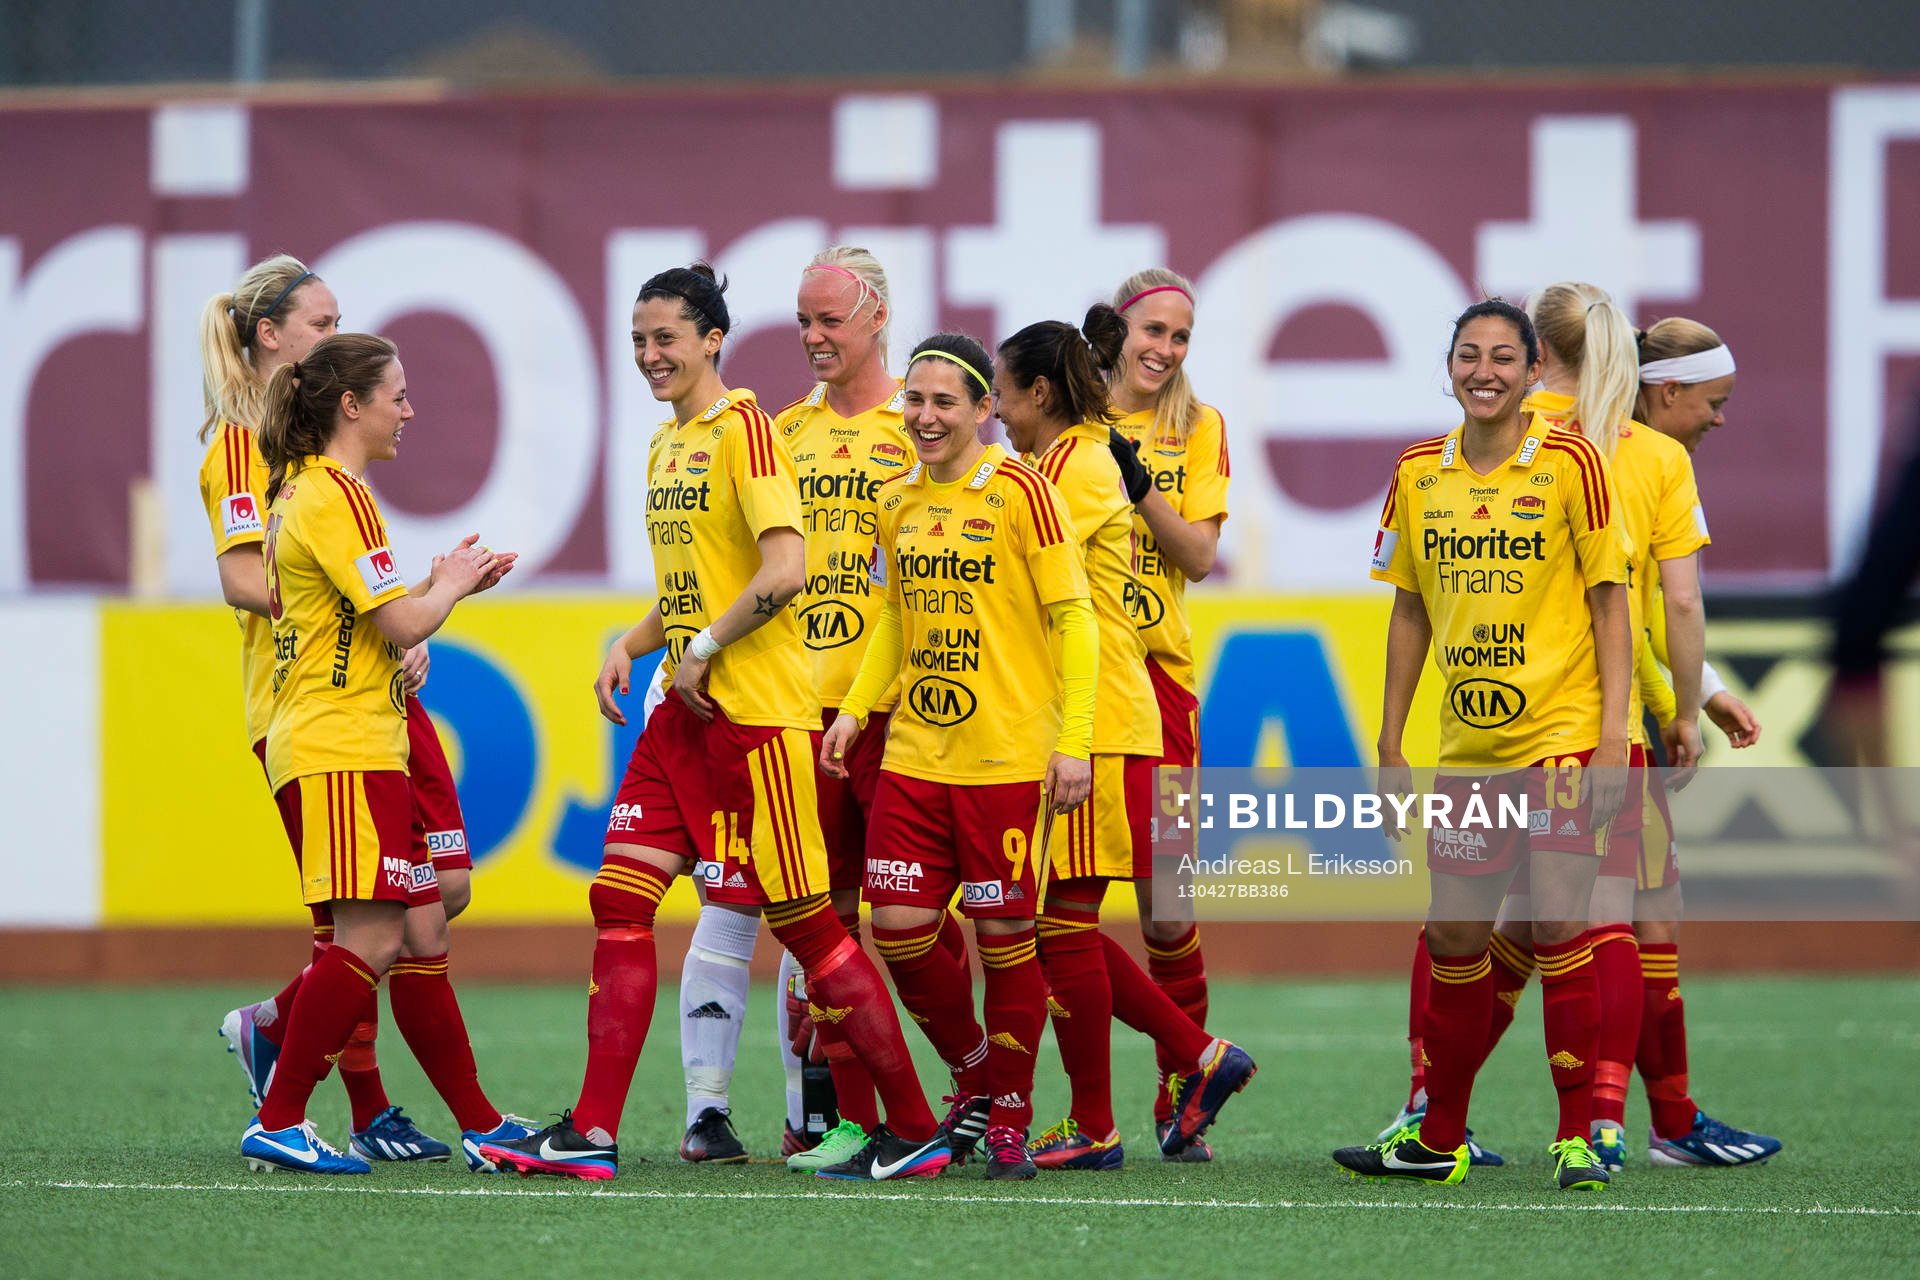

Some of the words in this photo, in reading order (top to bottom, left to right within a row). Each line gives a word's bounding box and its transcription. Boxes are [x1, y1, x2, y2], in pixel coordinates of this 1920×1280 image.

[0, 95, 1702, 592] rioritet
[829, 428, 860, 437] Prioritet
[799, 467, 885, 502] riorite
[1469, 487, 1499, 496] Prioritet
[928, 505, 952, 514] Prioritet
[1423, 510, 1453, 519] stadium
[900, 525, 918, 533] adium
[1424, 528, 1546, 561] Prioritet
[841, 552, 872, 577] UN
[372, 576, 399, 592] SVENSKA
[675, 571, 698, 592] UN
[1438, 561, 1524, 594] Finans
[659, 593, 703, 617] OMEN
[806, 611, 849, 640] KIA
[1491, 623, 1525, 644] UN
[332, 595, 355, 689] swedo
[945, 628, 980, 649] UN
[910, 648, 979, 672] WOMEN
[1445, 645, 1526, 667] WOMEN
[920, 685, 962, 715] KIA
[1460, 690, 1511, 717] KIA
[1158, 764, 1182, 816] 5
[1542, 756, 1582, 809] 13
[607, 818, 635, 832] KEL
[428, 832, 463, 850] BDO
[711, 810, 750, 864] 14
[1433, 826, 1487, 847] MEGA
[1002, 827, 1027, 881] 9
[1434, 843, 1487, 861] KAKEL
[867, 858, 923, 878] MEGA
[868, 875, 920, 892] KAKEL
[966, 882, 1000, 901] BDO
[687, 1011, 731, 1020] adidas
